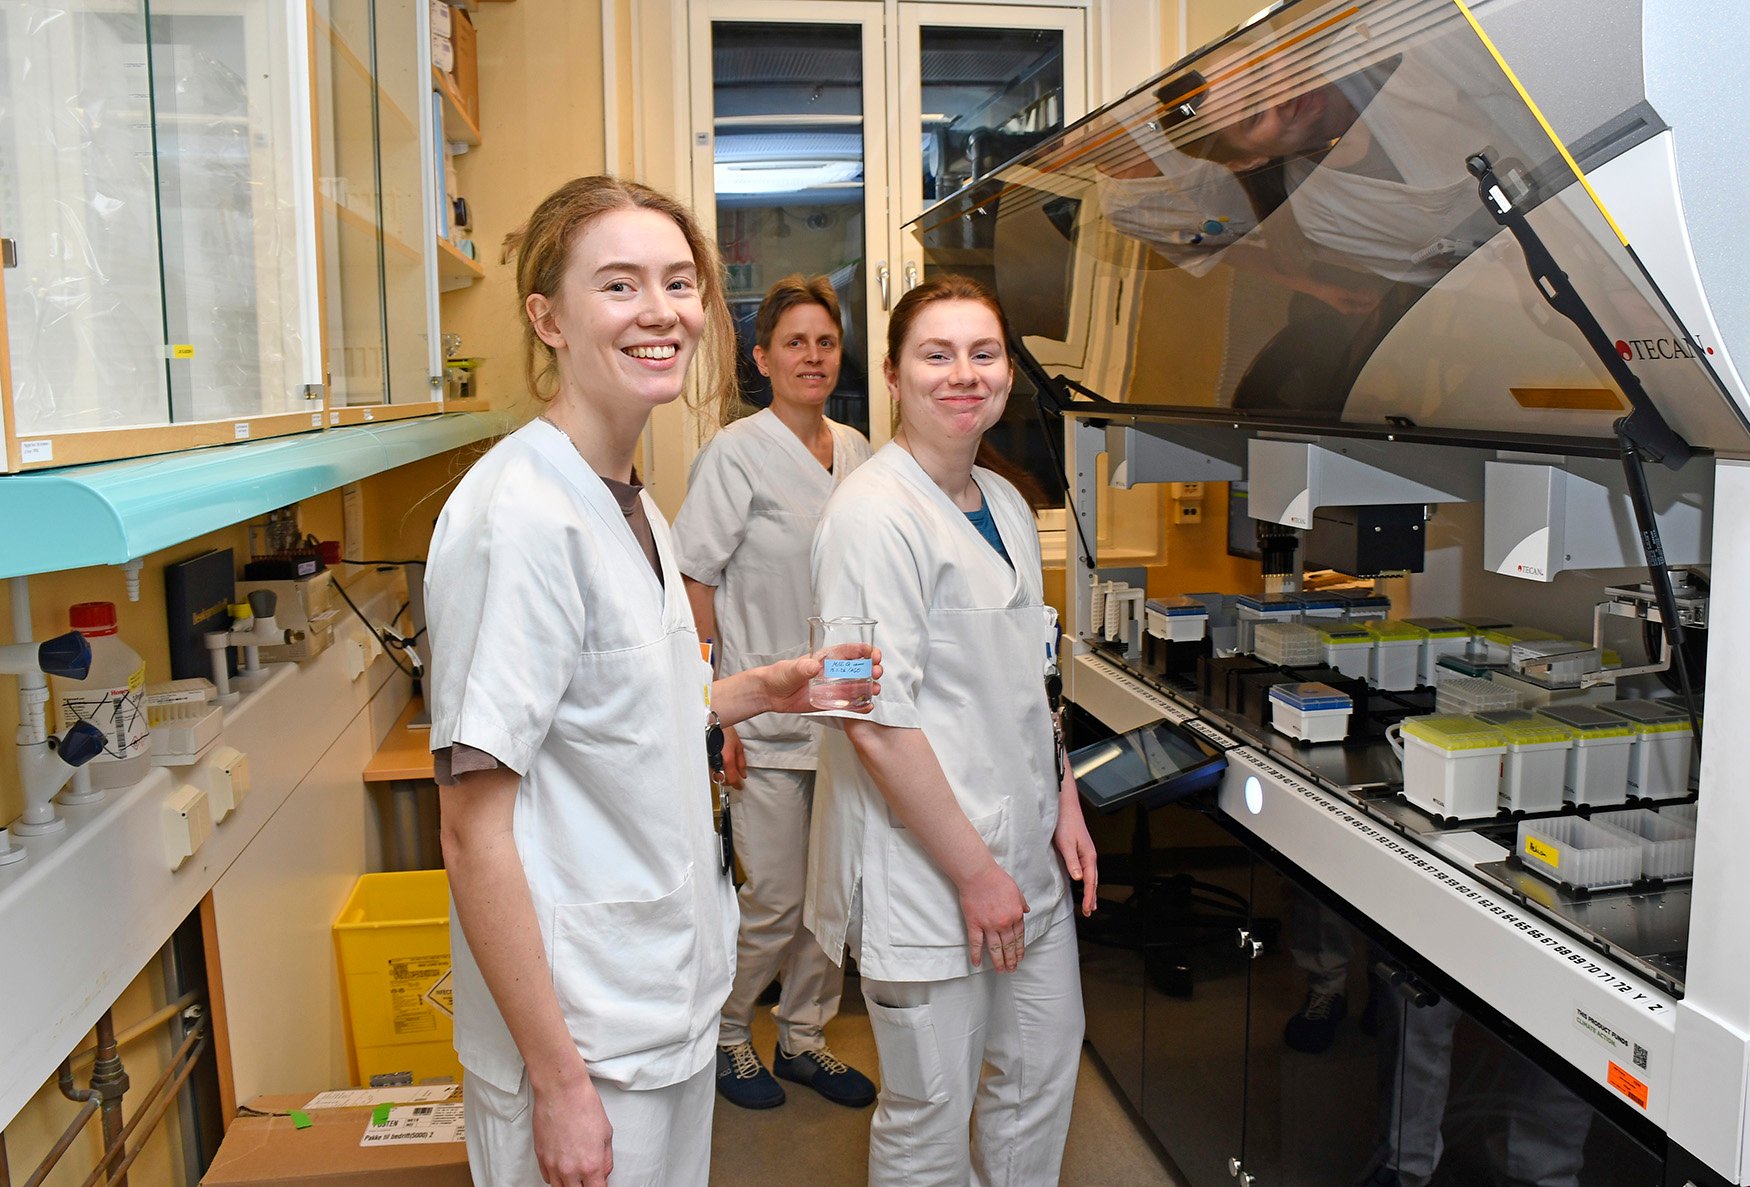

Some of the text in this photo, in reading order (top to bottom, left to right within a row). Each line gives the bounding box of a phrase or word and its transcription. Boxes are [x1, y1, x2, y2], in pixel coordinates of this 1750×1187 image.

[1629, 335, 1706, 360] TECAN
[1434, 872, 1449, 880] 58
[1444, 878, 1460, 887] 59
[1466, 892, 1482, 900] 61
[1478, 899, 1494, 908] 62
[1490, 906, 1506, 915] 63
[1502, 914, 1519, 923] 64
[1514, 922, 1532, 930] 65
[1527, 930, 1545, 939] 66
[1540, 938, 1558, 946] 67
[1554, 946, 1572, 955] 68
[1568, 955, 1586, 964] 69
[1583, 963, 1601, 973] 70
[1598, 972, 1616, 982] 71
[1613, 982, 1632, 992] 72
[1576, 1017, 1596, 1034] CLIMATE
[1588, 1016, 1611, 1034] PRODUCT
[1612, 1031, 1628, 1047] FUNDS
